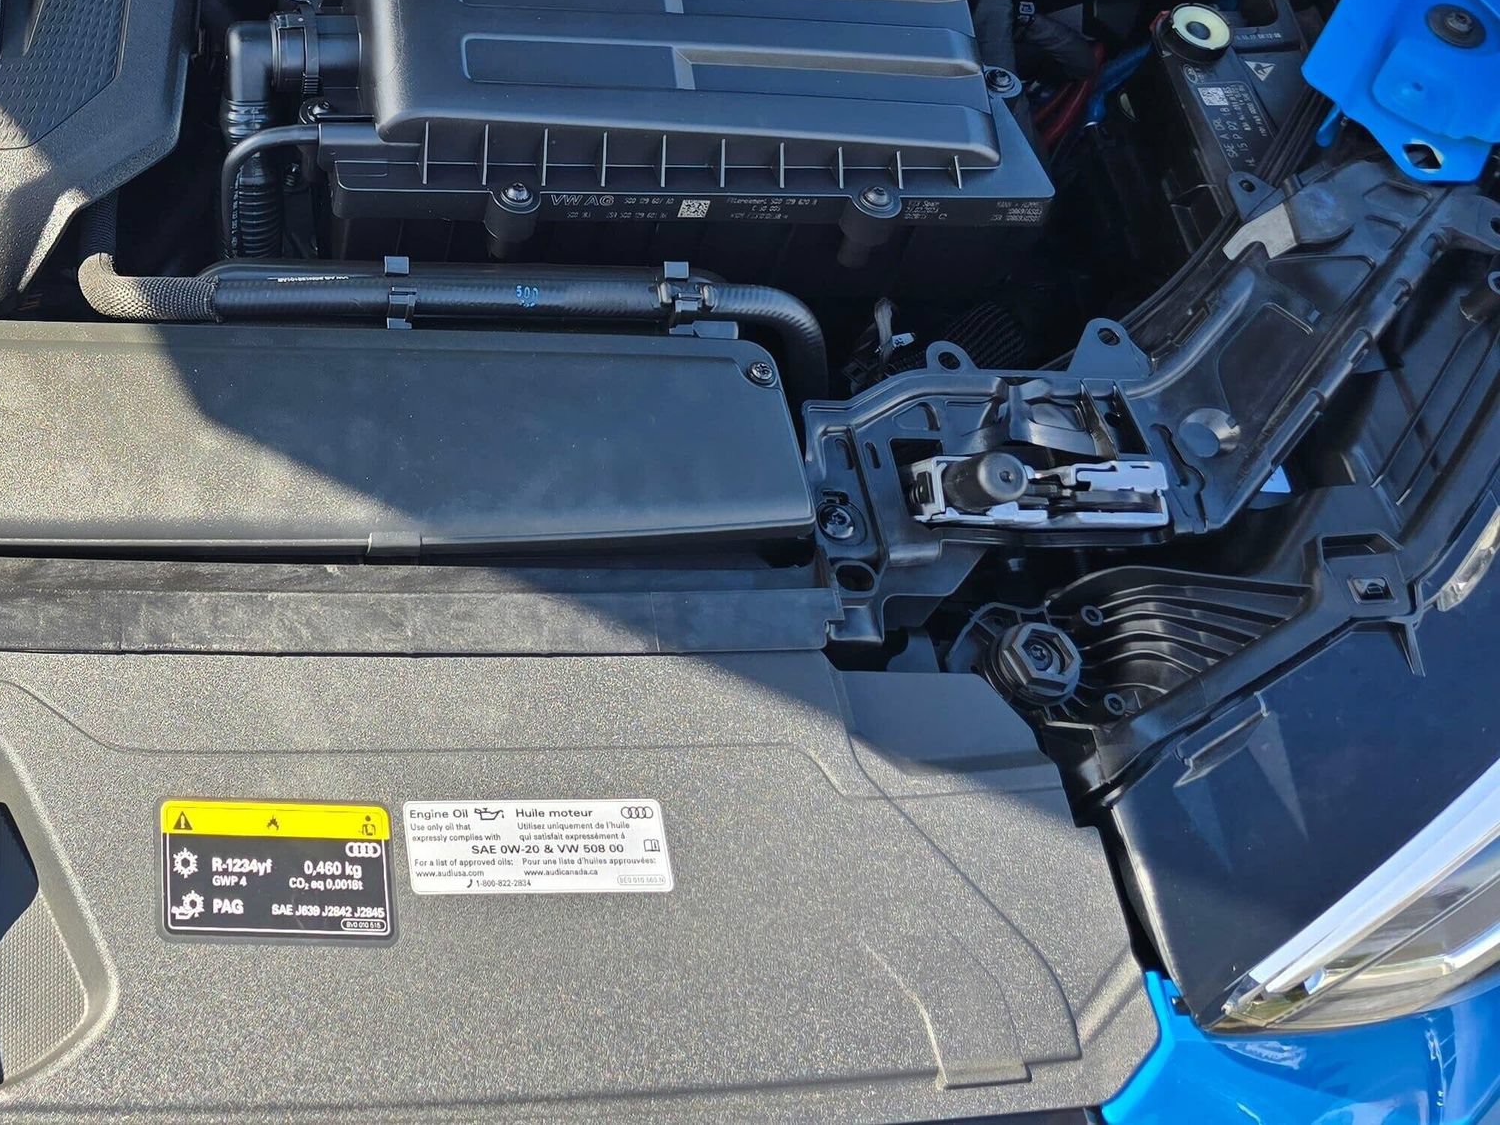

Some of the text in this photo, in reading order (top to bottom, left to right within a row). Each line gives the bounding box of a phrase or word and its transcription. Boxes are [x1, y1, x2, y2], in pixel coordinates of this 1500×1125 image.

[551, 194, 615, 206] VW AG
[516, 285, 539, 300] 500
[410, 809, 468, 820] Engine Oil
[516, 808, 593, 817] Huile moteur
[410, 823, 425, 831] Use
[427, 823, 443, 832] only
[445, 823, 454, 831] oil
[517, 822, 545, 830] Utilisez
[547, 822, 593, 831] uniquement
[606, 821, 630, 829] l'huile
[412, 833, 501, 842] expressly complies with
[519, 832, 531, 841] qui
[533, 832, 563, 840] satisfait
[565, 832, 618, 841] expressément
[471, 844, 624, 854] SAE 0W-20 & VW 508 00
[459, 859, 495, 867] approved
[577, 857, 607, 865] d'huiles
[609, 857, 656, 866] approuvées:
[212, 857, 363, 878] R-1234yf 0,460 kg
[524, 868, 598, 876] www.audicanada.ca
[416, 869, 484, 877] www.audiusa.com
[212, 876, 247, 887] GWP 4
[311, 880, 324, 891] eq
[476, 879, 531, 887] 1-800-822-2834
[213, 898, 244, 914] PAG
[272, 904, 385, 918] SAE J639 J2842 J2845
